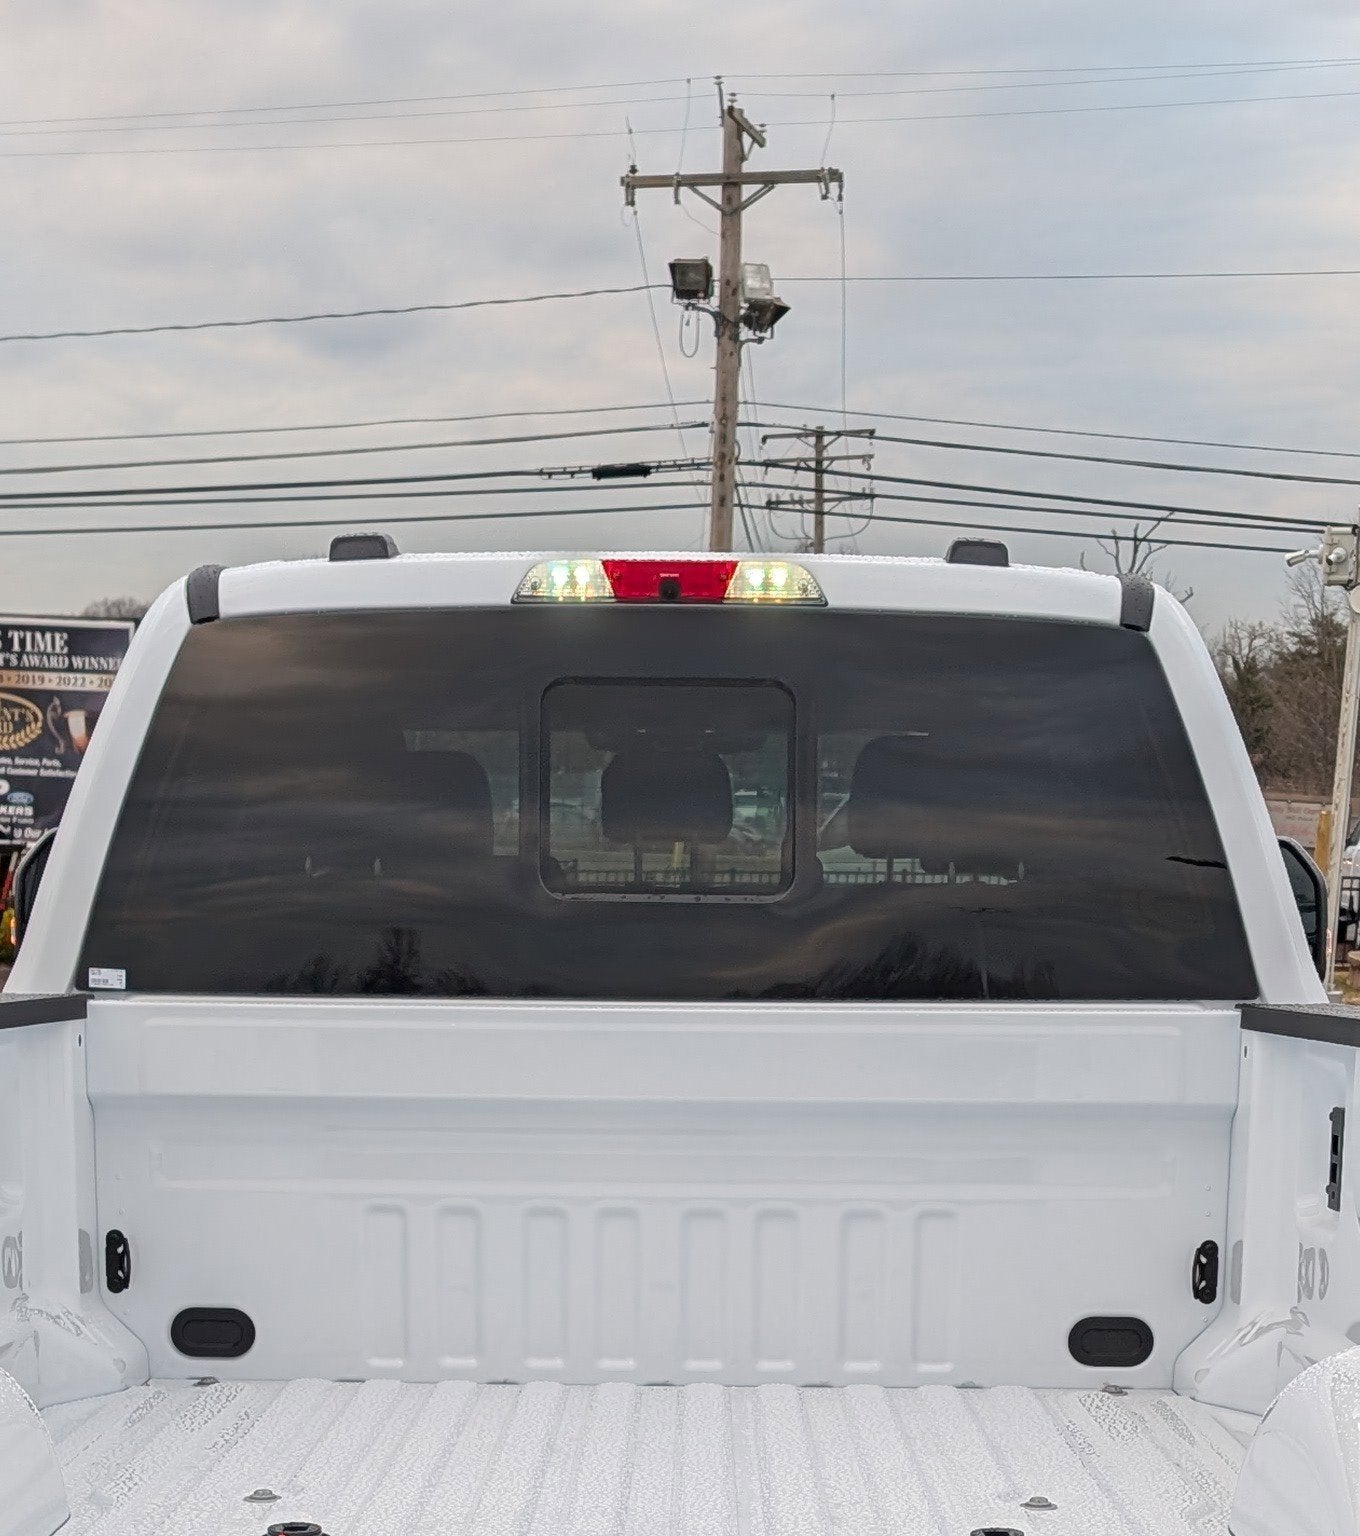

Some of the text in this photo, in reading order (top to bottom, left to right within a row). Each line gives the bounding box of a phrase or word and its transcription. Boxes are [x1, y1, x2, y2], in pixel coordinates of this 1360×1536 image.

[7, 630, 69, 654] TIME
[20, 653, 70, 669] AWARD
[15, 673, 46, 685] 2019
[56, 675, 87, 687] 2022
